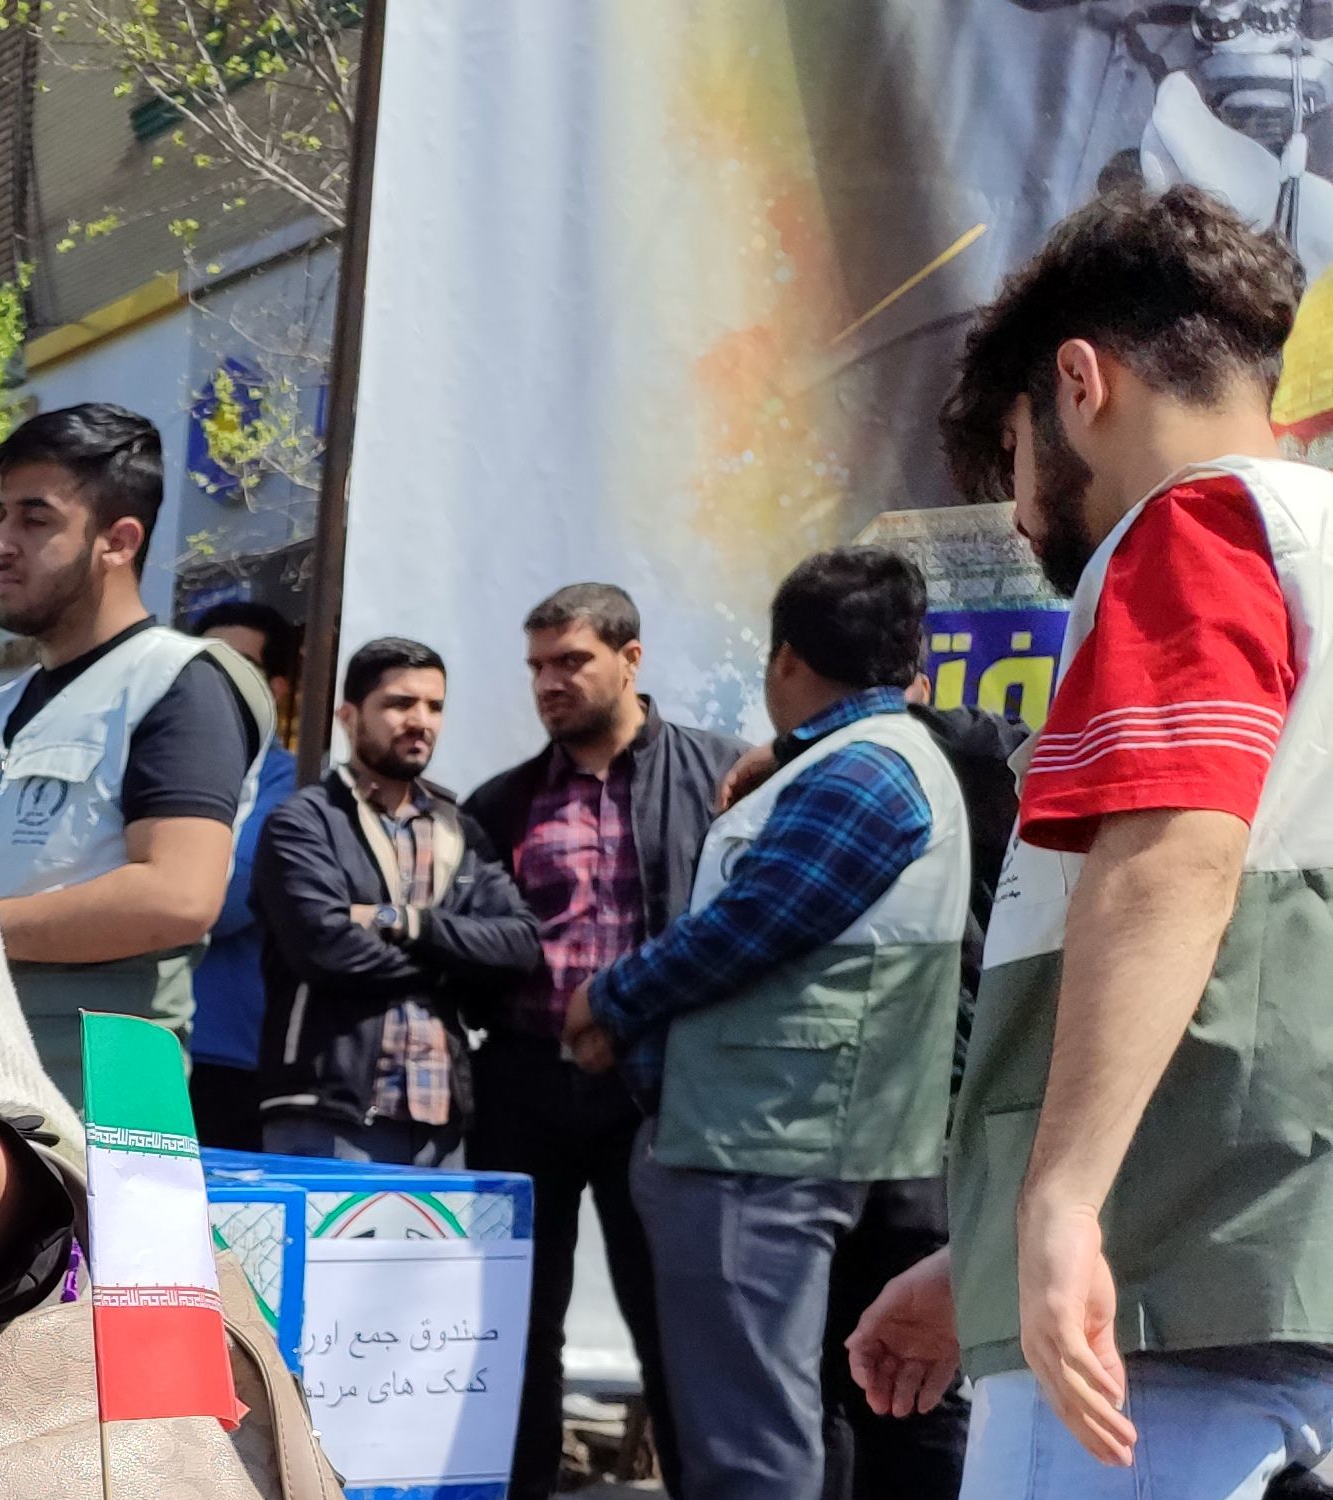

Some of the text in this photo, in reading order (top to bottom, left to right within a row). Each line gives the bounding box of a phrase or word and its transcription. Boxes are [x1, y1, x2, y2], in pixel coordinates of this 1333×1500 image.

[349, 1328, 401, 1359] جمع
[410, 1318, 500, 1352] صندوق
[368, 1370, 414, 1405] های
[425, 1367, 489, 1395] کمک
